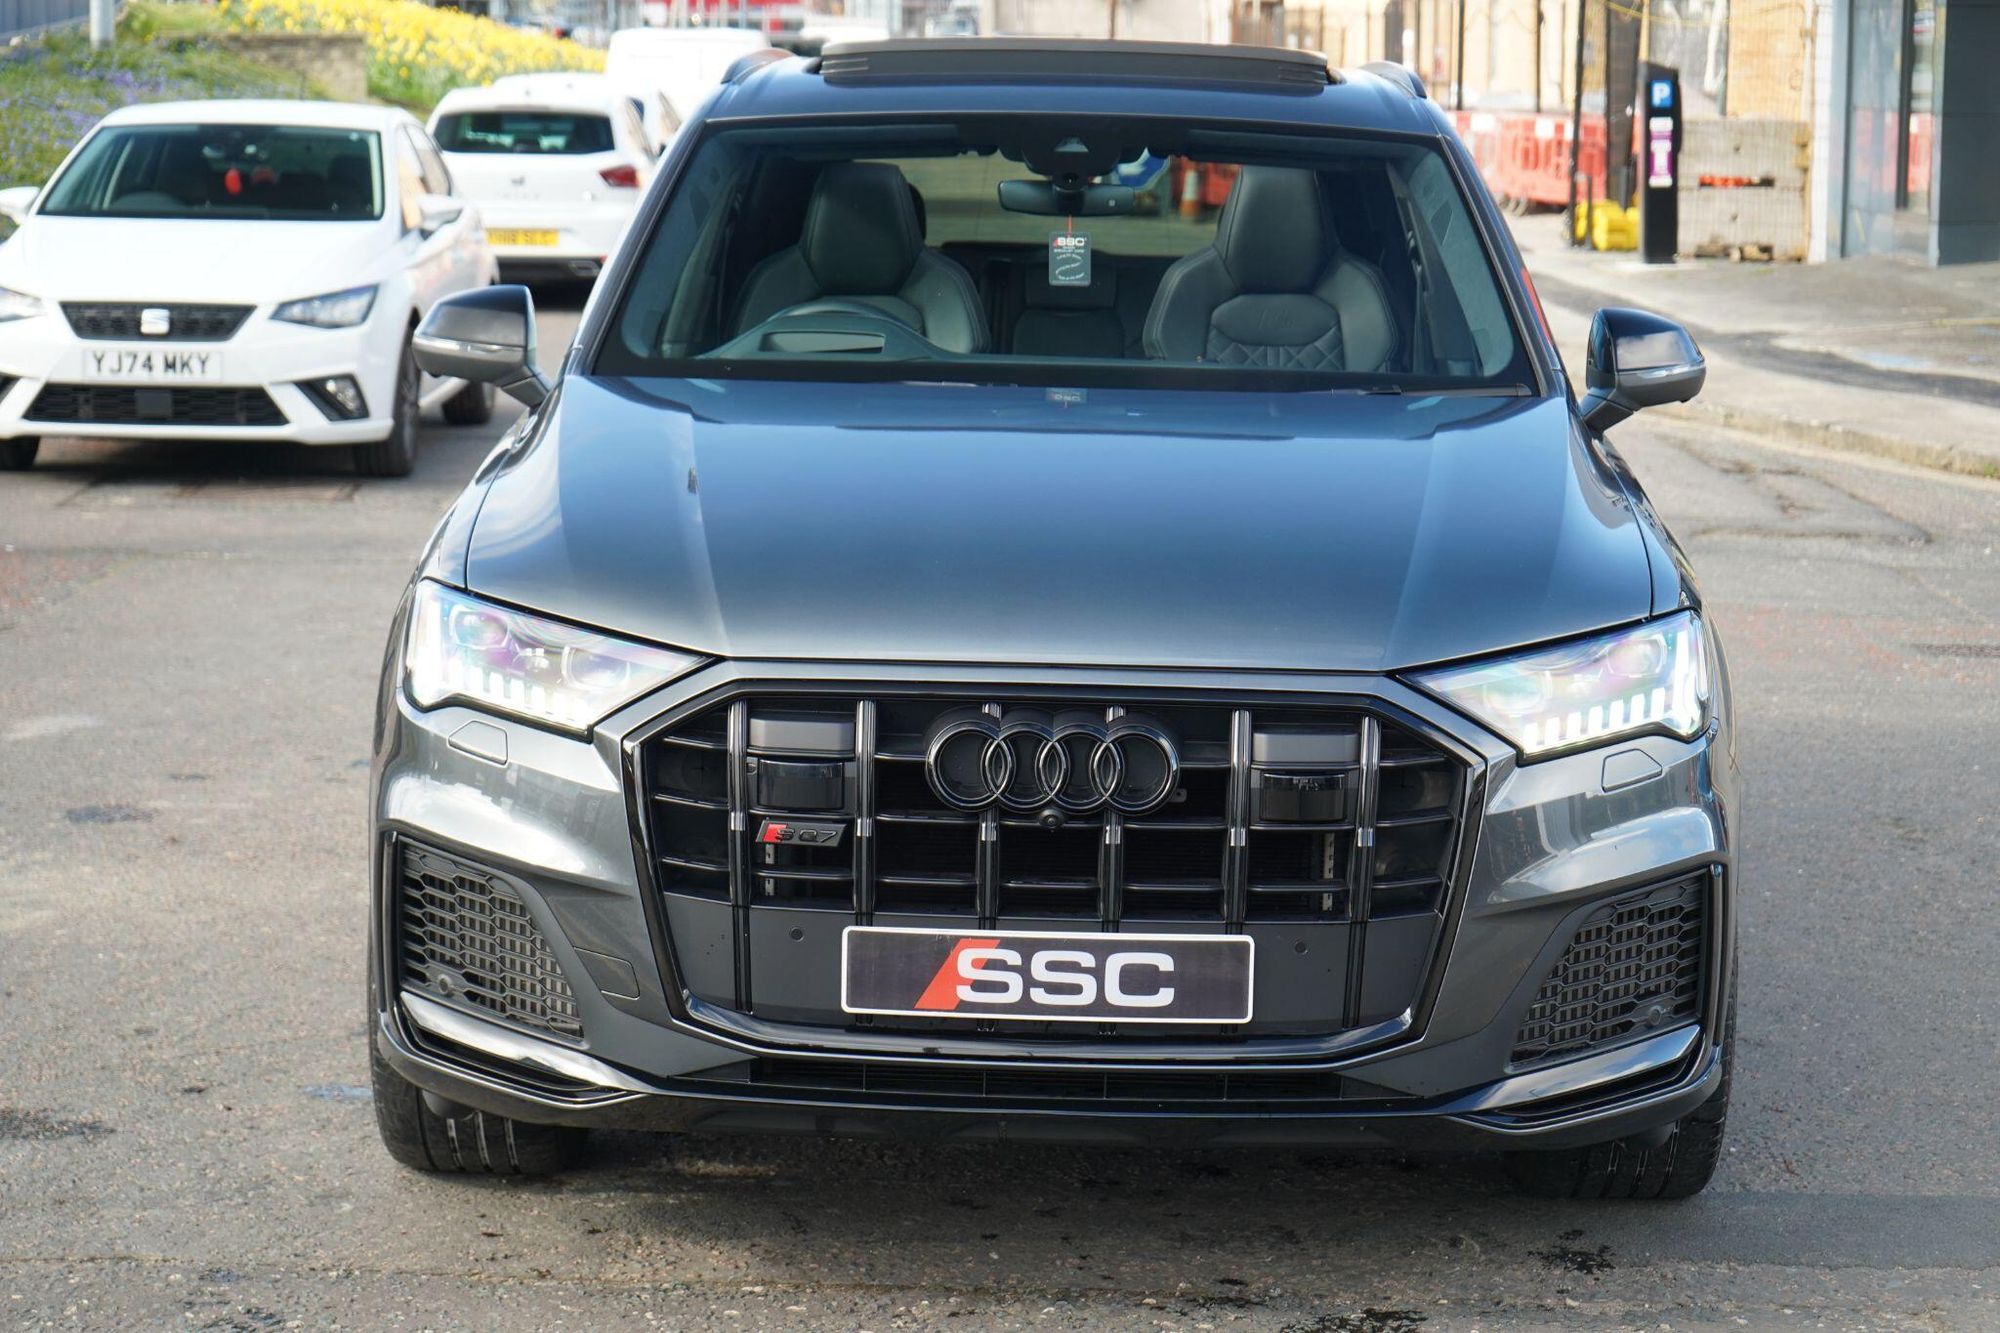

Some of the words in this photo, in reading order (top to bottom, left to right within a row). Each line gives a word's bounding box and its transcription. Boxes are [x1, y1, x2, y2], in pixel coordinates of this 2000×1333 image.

[1652, 82, 1671, 107] P
[93, 351, 154, 373] YJ74
[163, 351, 210, 373] MKY
[775, 828, 837, 843] SQ7
[956, 948, 1175, 1007] SSC
